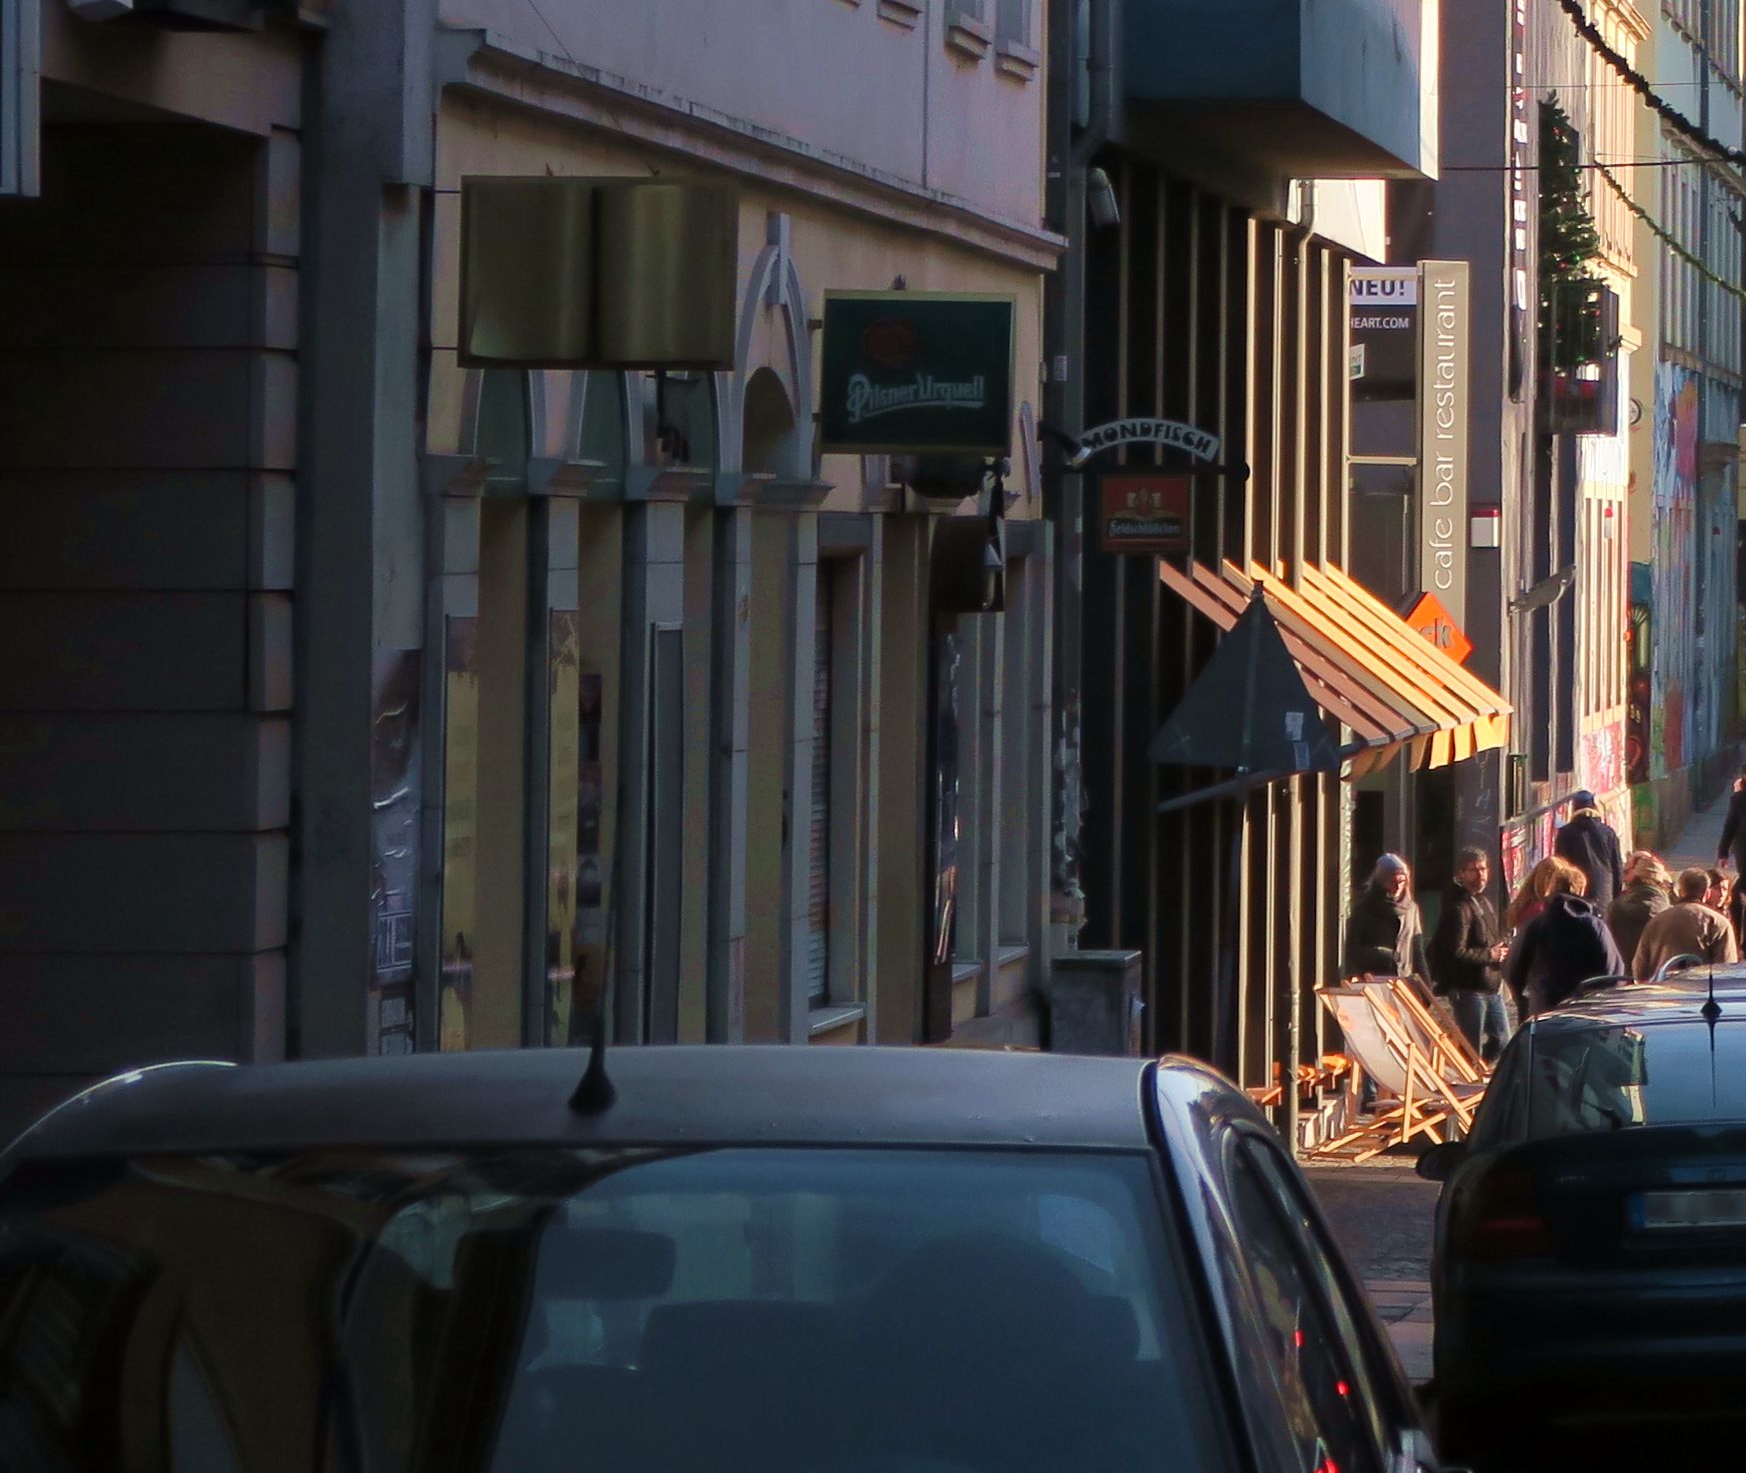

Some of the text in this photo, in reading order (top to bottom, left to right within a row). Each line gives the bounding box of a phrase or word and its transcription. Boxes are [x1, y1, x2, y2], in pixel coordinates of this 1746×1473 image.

[846, 372, 985, 424] Pilsner Urquell
[1081, 422, 1212, 455] MONDFISCH
[1430, 279, 1456, 589] cafe bar restaurant
